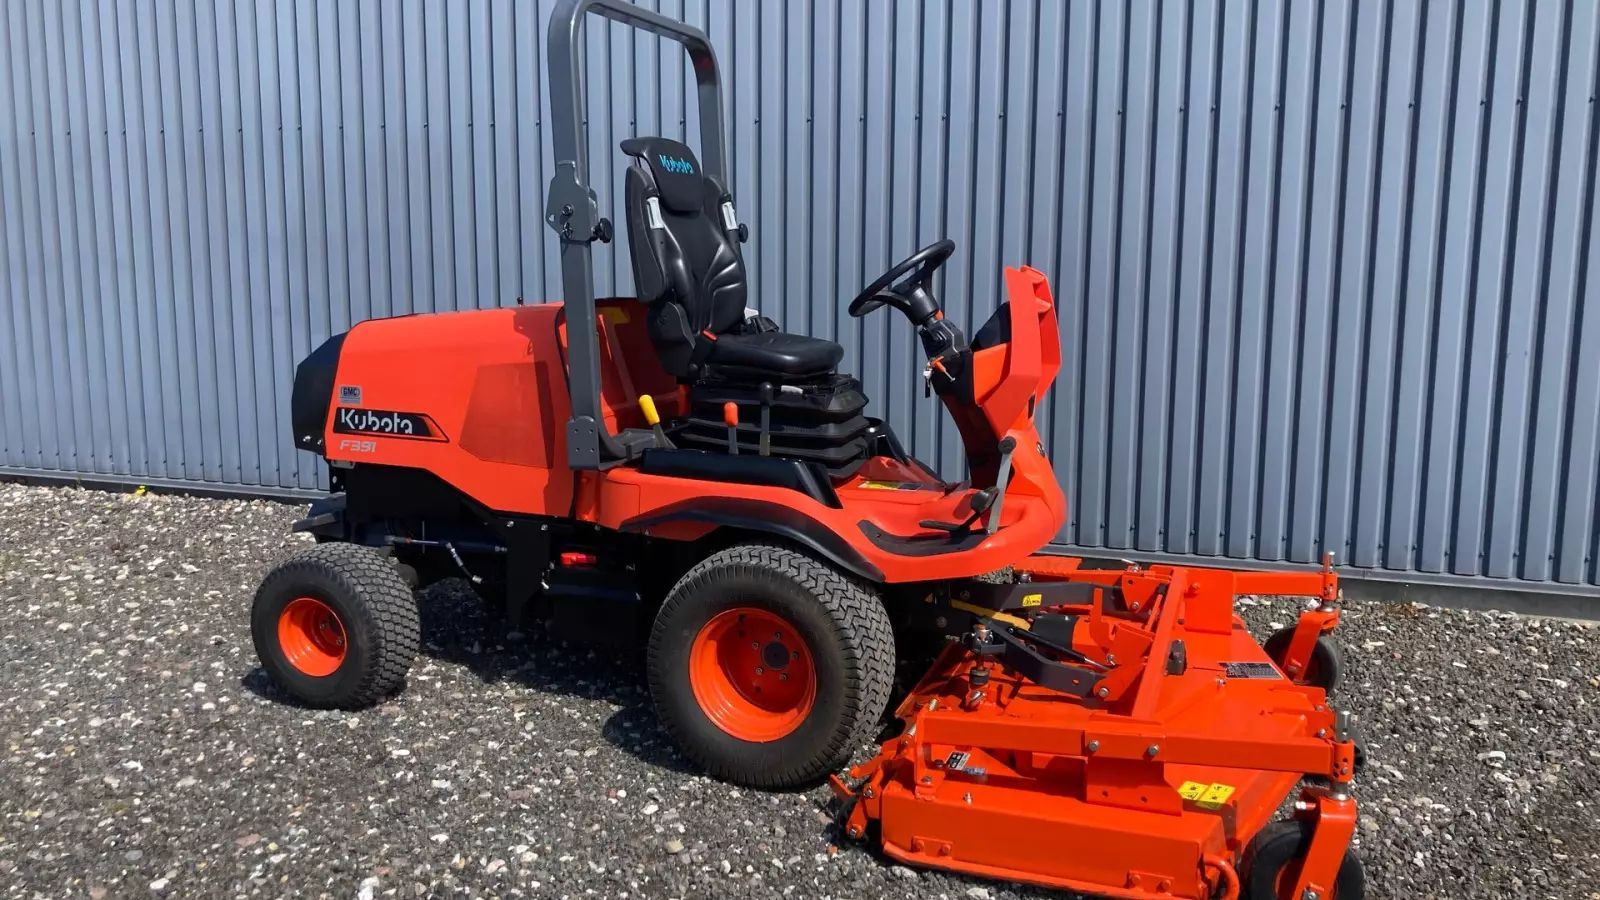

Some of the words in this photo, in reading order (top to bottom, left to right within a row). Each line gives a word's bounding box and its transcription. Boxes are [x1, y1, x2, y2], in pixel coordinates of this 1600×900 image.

[659, 154, 694, 174] Kubota
[340, 408, 413, 434] Kubota
[340, 440, 377, 452] F391
